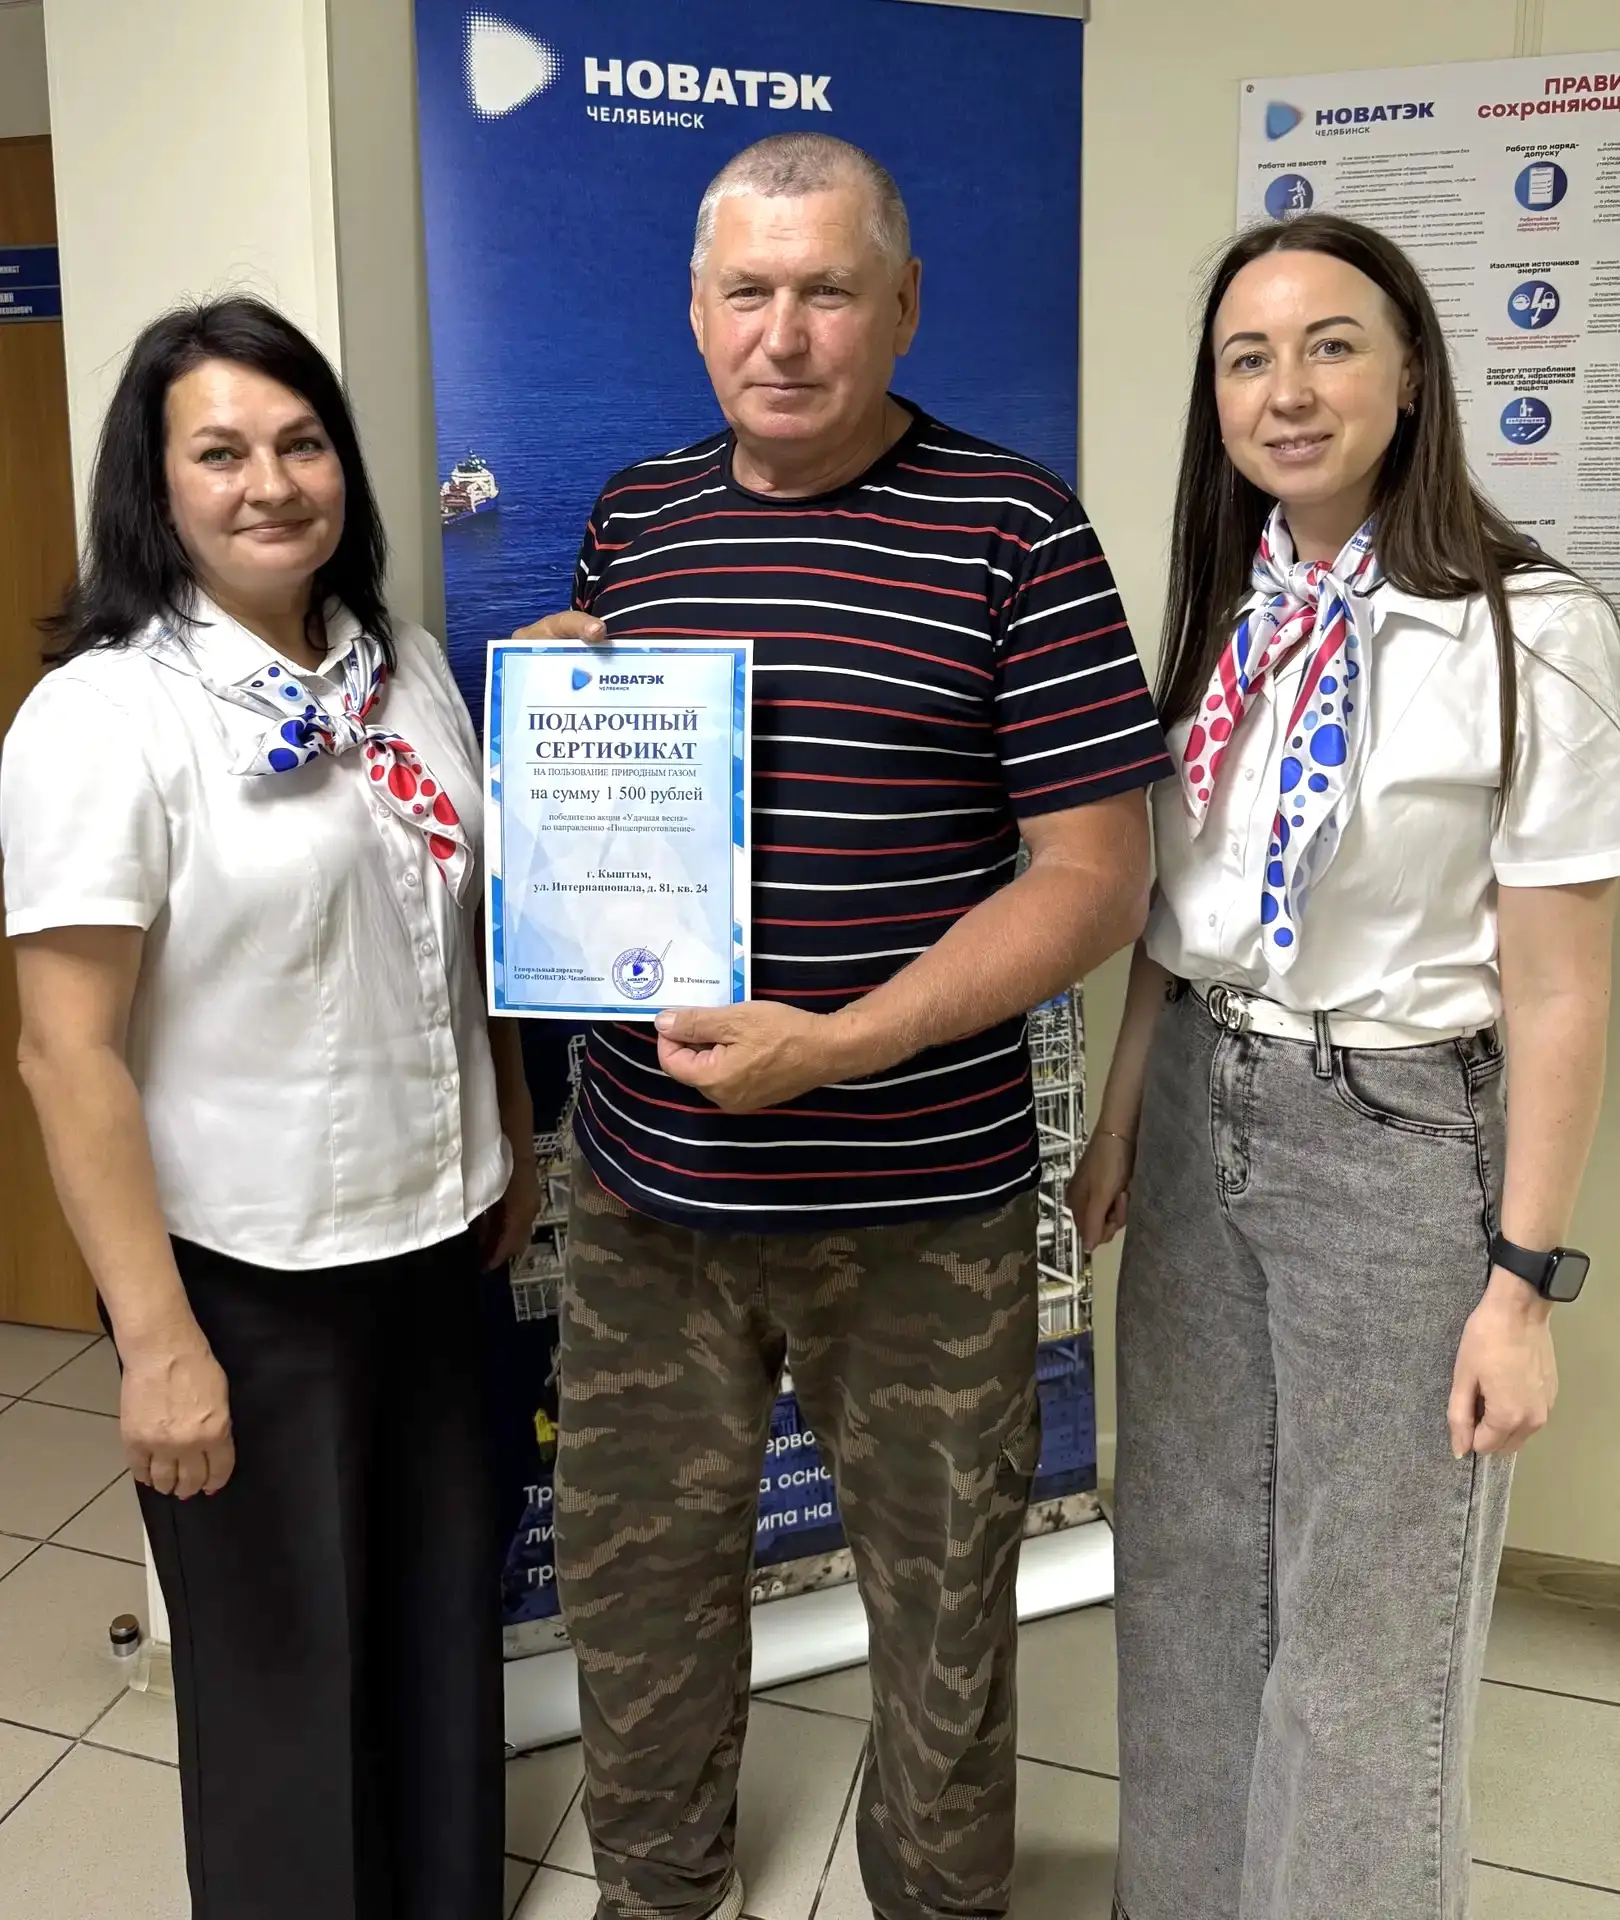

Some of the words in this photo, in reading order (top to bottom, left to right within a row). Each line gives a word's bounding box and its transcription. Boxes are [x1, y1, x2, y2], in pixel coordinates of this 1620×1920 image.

[584, 56, 833, 112] НОВАТЭК
[1544, 74, 1620, 95] ПРАВИ
[1315, 101, 1435, 126] НОВАТЭК
[1477, 96, 1620, 121] сохраняющ
[586, 105, 705, 130] ЧЕЛЯБИНСК
[1315, 126, 1371, 138] ЧЕЛЯБИНСК
[1505, 144, 1535, 152] Работа
[1537, 144, 1548, 152] по
[1549, 142, 1580, 152] наряд-
[1524, 150, 1560, 158] допуску
[1257, 162, 1286, 170] Работа
[1490, 262, 1530, 270] Изоляция
[1517, 267, 1551, 275] энергии
[1517, 366, 1576, 374] употребления
[600, 674, 664, 684] НОВАТЭК
[528, 710, 698, 734] ПОДАРОЧНЫЙ
[536, 741, 698, 760] СЕРТИФИКАТ
[533, 768, 546, 776] НА
[548, 768, 609, 777] ПОЛЬЗОВАНИЕ
[611, 768, 666, 778] ПРИРОДНЫМ
[668, 769, 697, 777] ГАЗОМ
[530, 789, 548, 800] на
[552, 788, 600, 804] сумму
[607, 787, 613, 800] 1
[619, 787, 646, 800] 500
[650, 786, 703, 804] рублей
[549, 814, 596, 822] победителю
[622, 814, 660, 822] «Удачная
[553, 824, 604, 832] направлению
[586, 871, 595, 879] г.
[598, 870, 652, 880] Кыштым,
[533, 884, 550, 894] ул.
[552, 882, 645, 894] Интернационала,
[646, 885, 656, 894] д.
[659, 883, 674, 894] 81,
[677, 885, 693, 893] кв.
[696, 883, 708, 894] 24
[804, 1502, 832, 1522] на
